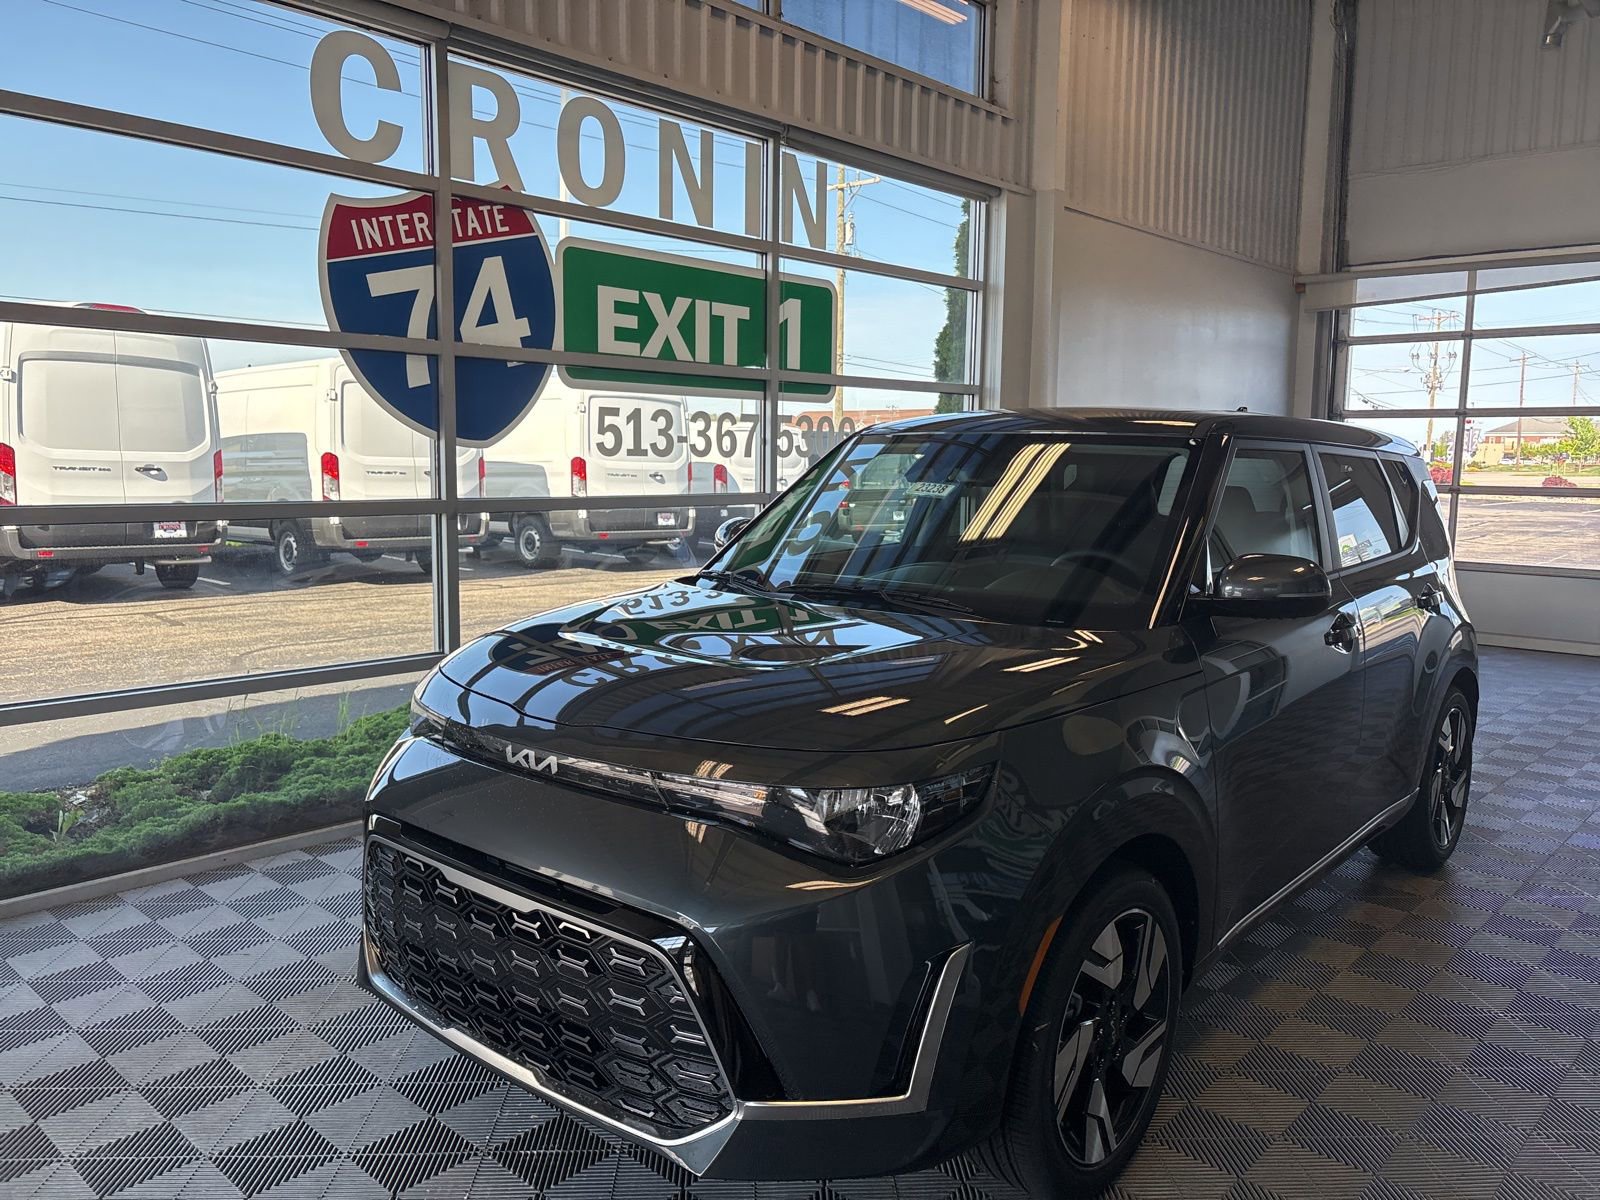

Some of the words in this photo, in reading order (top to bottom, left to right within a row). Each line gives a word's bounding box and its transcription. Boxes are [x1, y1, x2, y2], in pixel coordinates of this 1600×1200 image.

[310, 30, 828, 249] CRONIN
[351, 205, 509, 250] INTERTATE
[366, 255, 532, 389] 74
[597, 284, 750, 367] EXIT
[778, 298, 802, 370] 1
[506, 744, 558, 775] KIA
